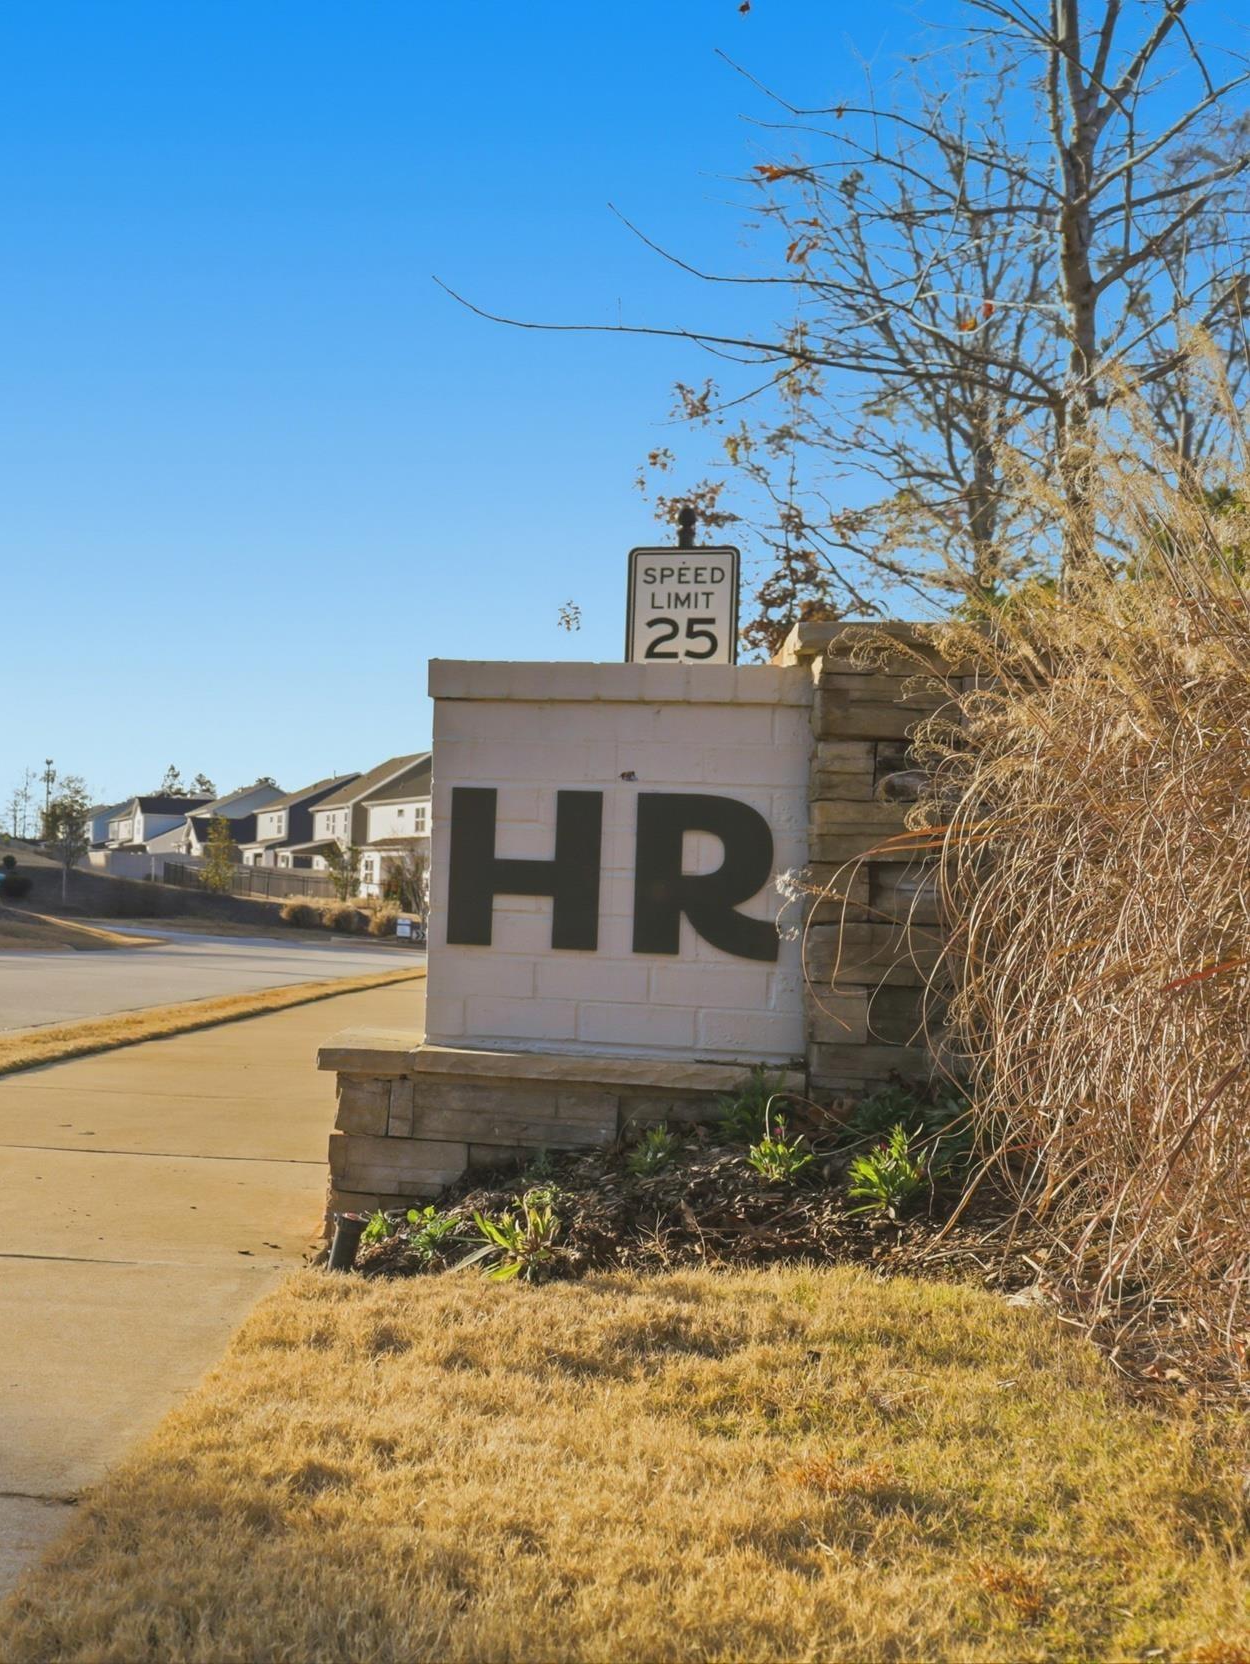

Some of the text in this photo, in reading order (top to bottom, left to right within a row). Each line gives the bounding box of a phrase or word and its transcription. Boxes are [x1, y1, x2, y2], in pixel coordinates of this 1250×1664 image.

[642, 567, 726, 585] SPEED
[650, 592, 715, 610] LIMIT
[644, 617, 719, 660] 25
[446, 786, 780, 962] HR
